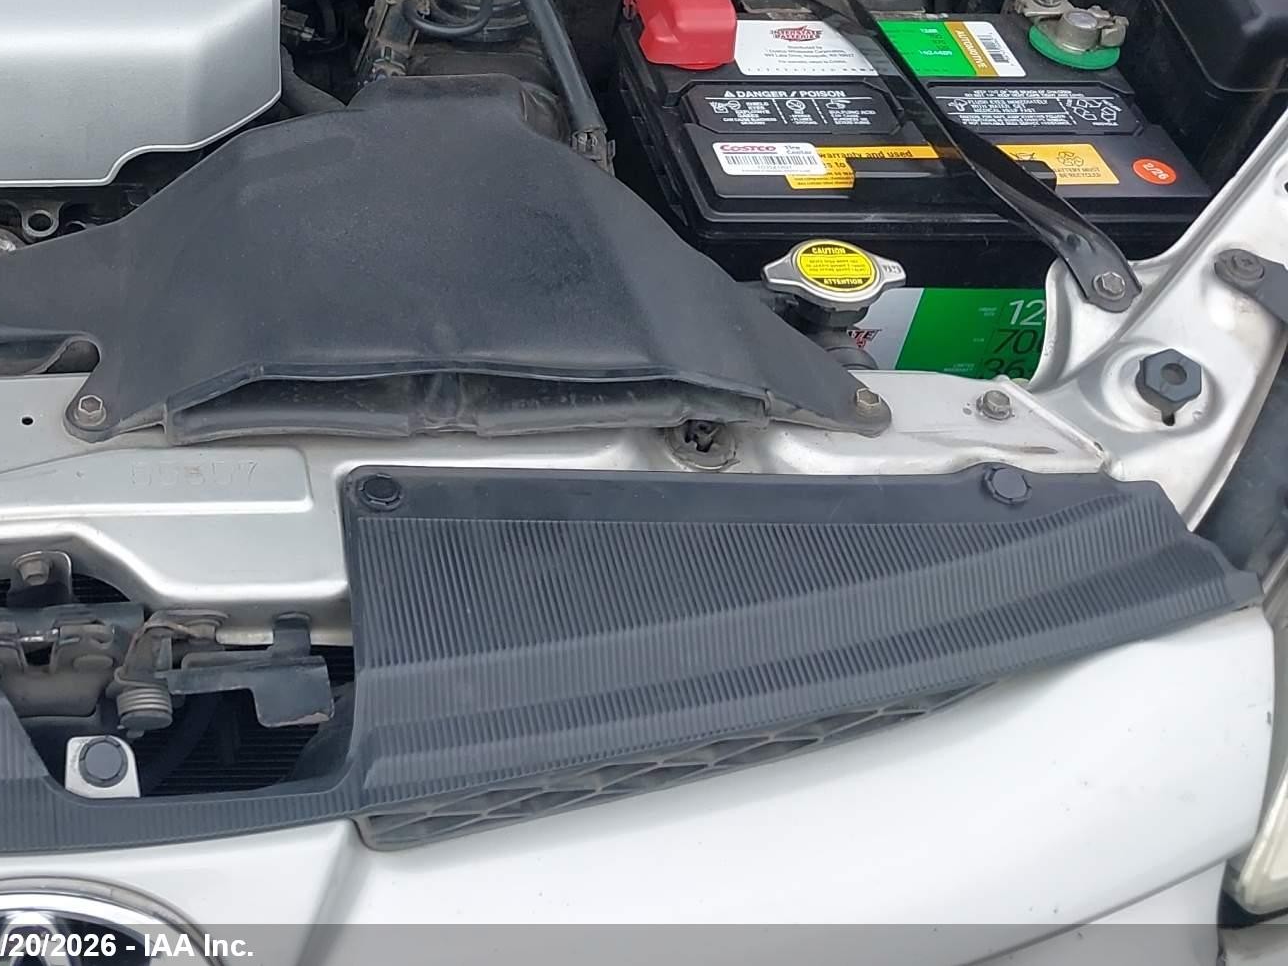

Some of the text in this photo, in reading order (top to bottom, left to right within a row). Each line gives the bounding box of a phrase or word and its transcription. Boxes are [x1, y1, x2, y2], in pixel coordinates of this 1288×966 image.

[955, 29, 988, 69] AUTOMOTIVE
[735, 90, 787, 98] DANGER
[799, 90, 846, 98] POISON
[818, 149, 912, 160] warranty and used
[1142, 162, 1169, 181] 2/26
[1009, 299, 1046, 325] 12
